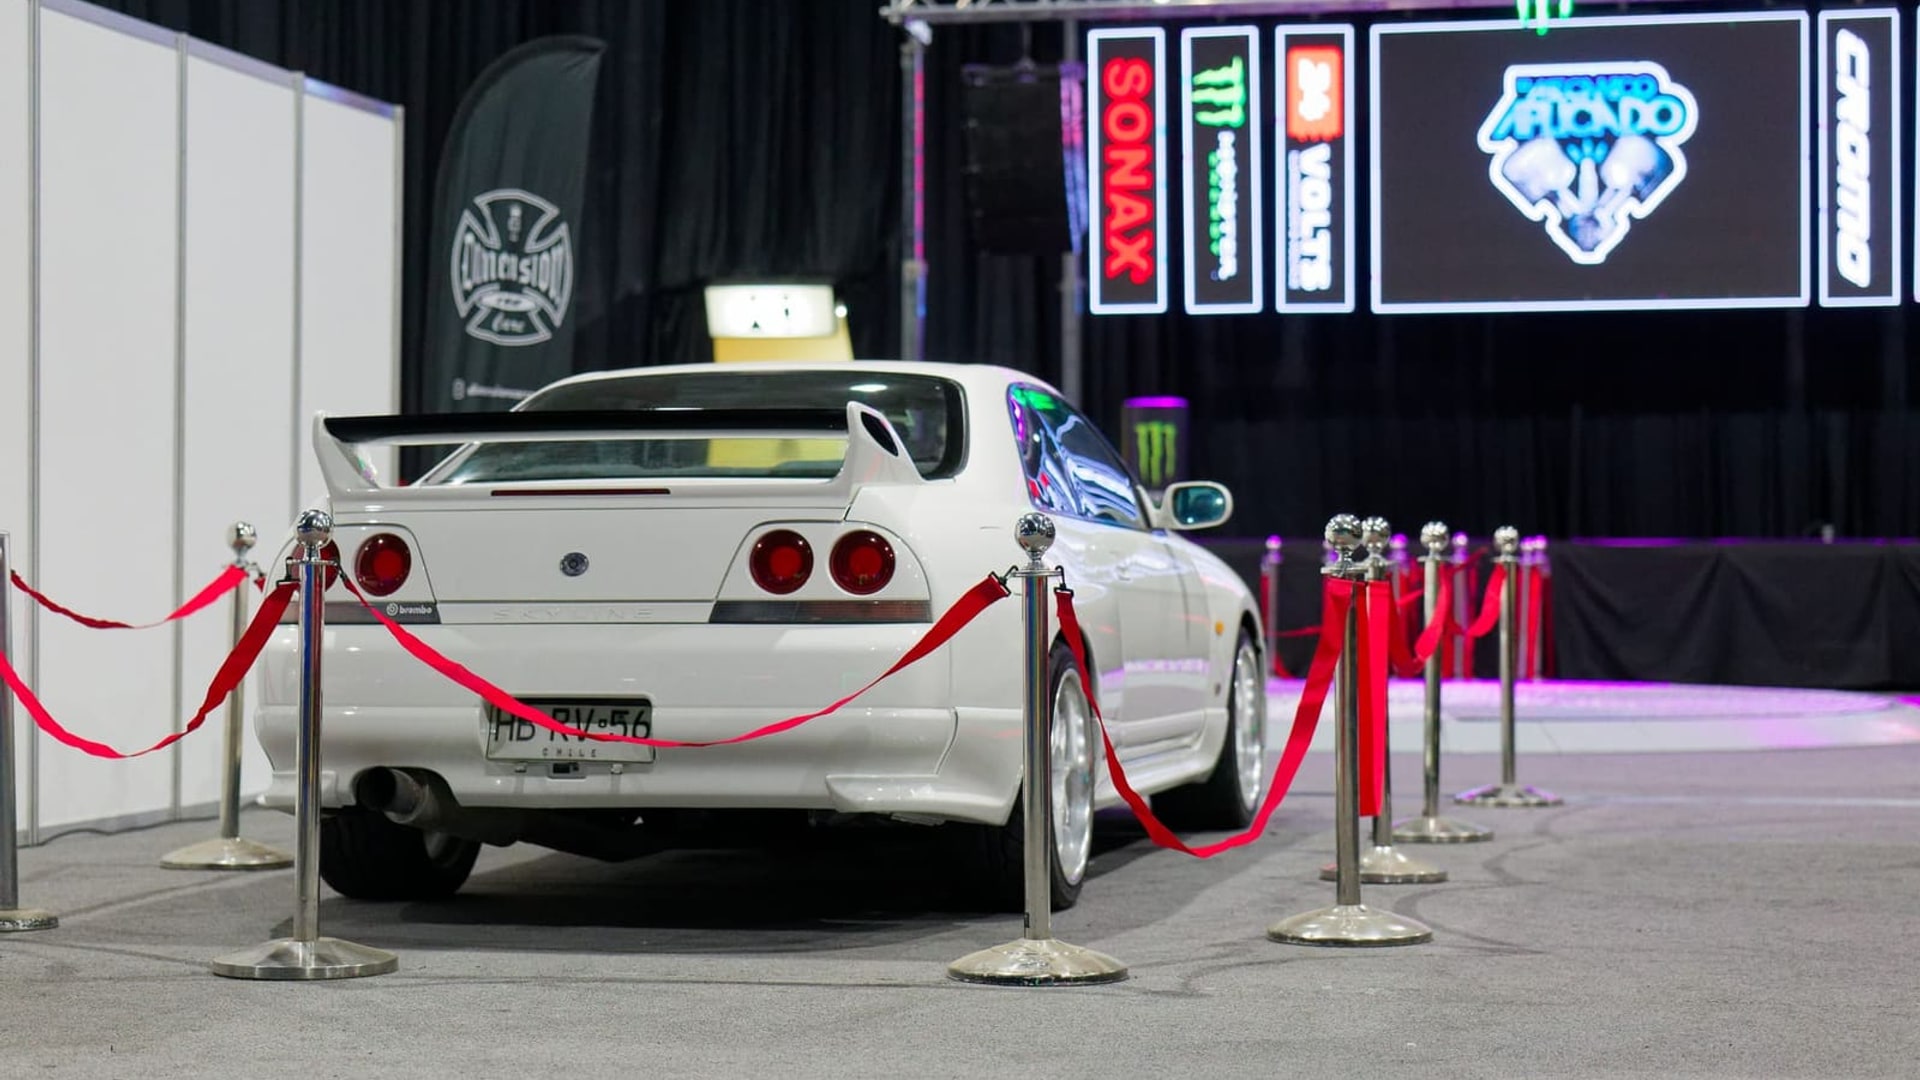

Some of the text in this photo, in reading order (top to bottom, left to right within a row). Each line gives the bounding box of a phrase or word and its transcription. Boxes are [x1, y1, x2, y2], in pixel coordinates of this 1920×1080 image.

[1103, 57, 1153, 285] SONAX
[1300, 143, 1332, 291] VOLTS
[1836, 28, 1870, 288] CROMO
[399, 604, 433, 615] brembo
[541, 746, 598, 759] CHILE
